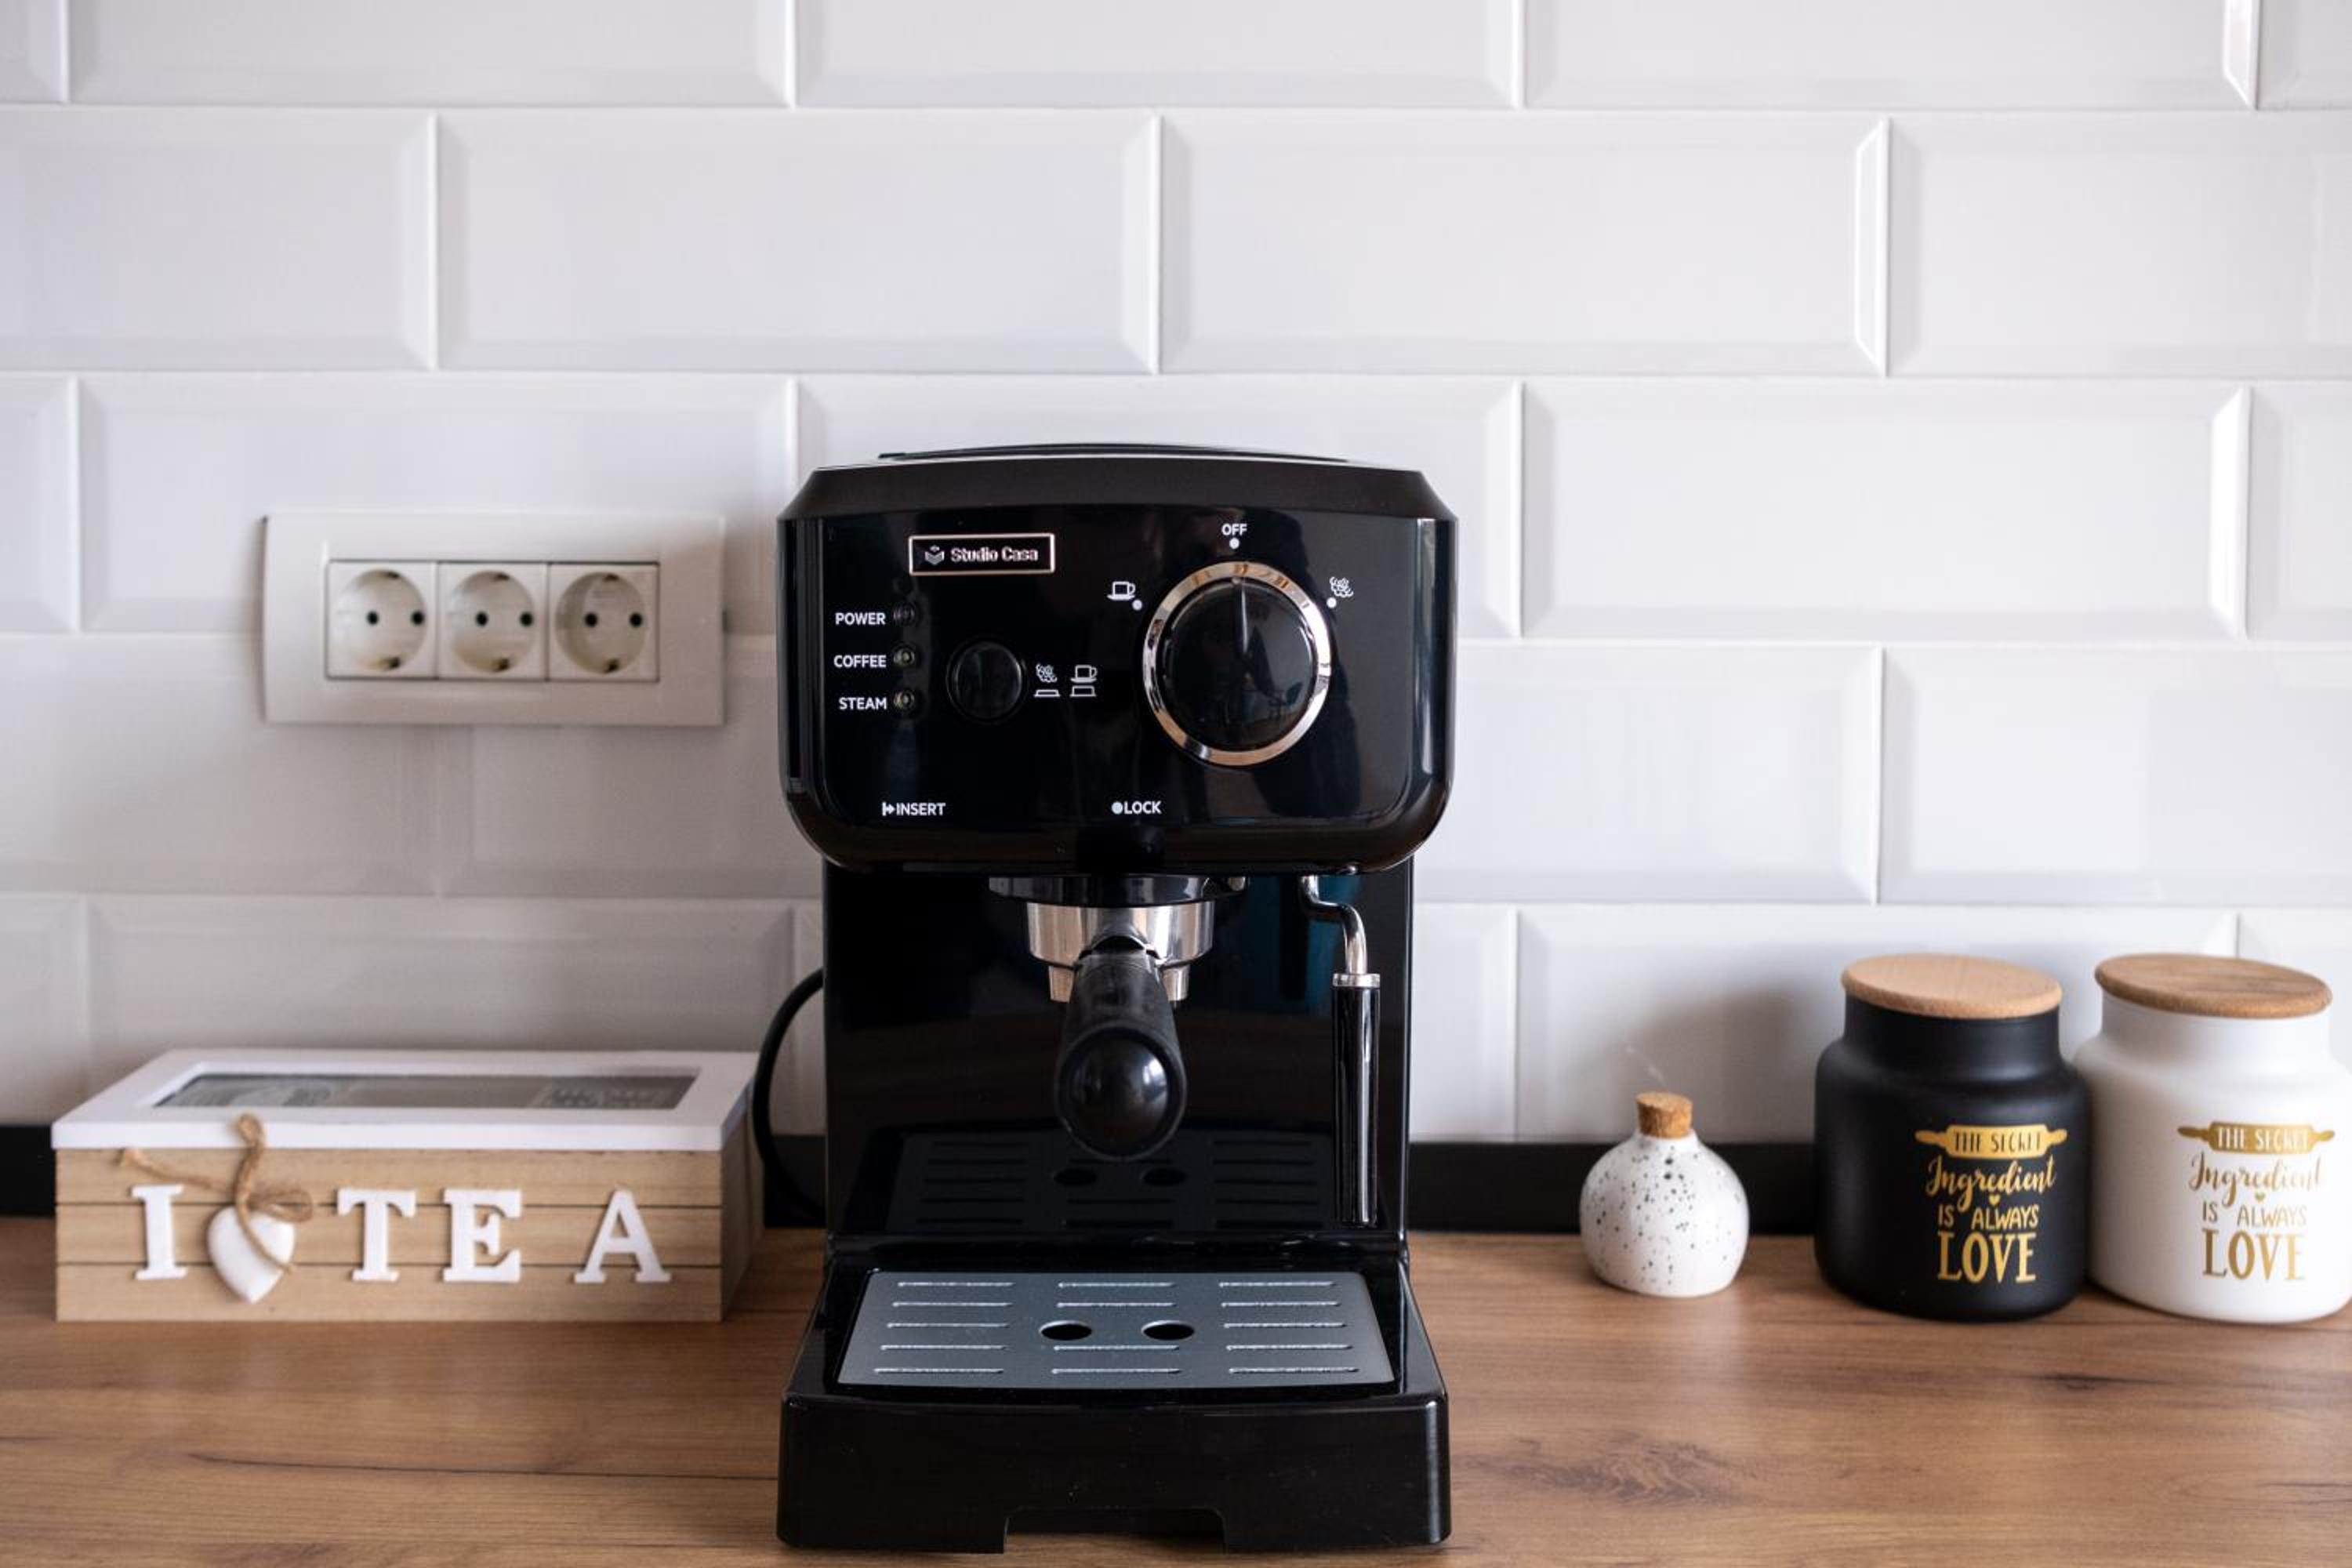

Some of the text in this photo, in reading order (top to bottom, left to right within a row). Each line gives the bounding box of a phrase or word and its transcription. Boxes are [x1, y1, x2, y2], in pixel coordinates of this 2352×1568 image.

[1221, 523, 1247, 536] OFF
[949, 545, 1039, 563] Studio Casa
[835, 612, 886, 626] POWER
[833, 654, 887, 669] COFFEE
[838, 696, 887, 710] STEAM
[895, 801, 946, 816] INSERT
[1123, 800, 1162, 815] LOCK
[2217, 1126, 2310, 1151] THE SECRET
[1926, 1154, 2056, 1212] Ingredient
[2188, 1151, 2321, 1207] Ingredient
[1937, 1203, 2040, 1230] IS ALWAYS
[2201, 1200, 2308, 1228] IS ALWAYS
[1936, 1230, 2037, 1283] LOVE
[2201, 1228, 2307, 1281] LOVE
